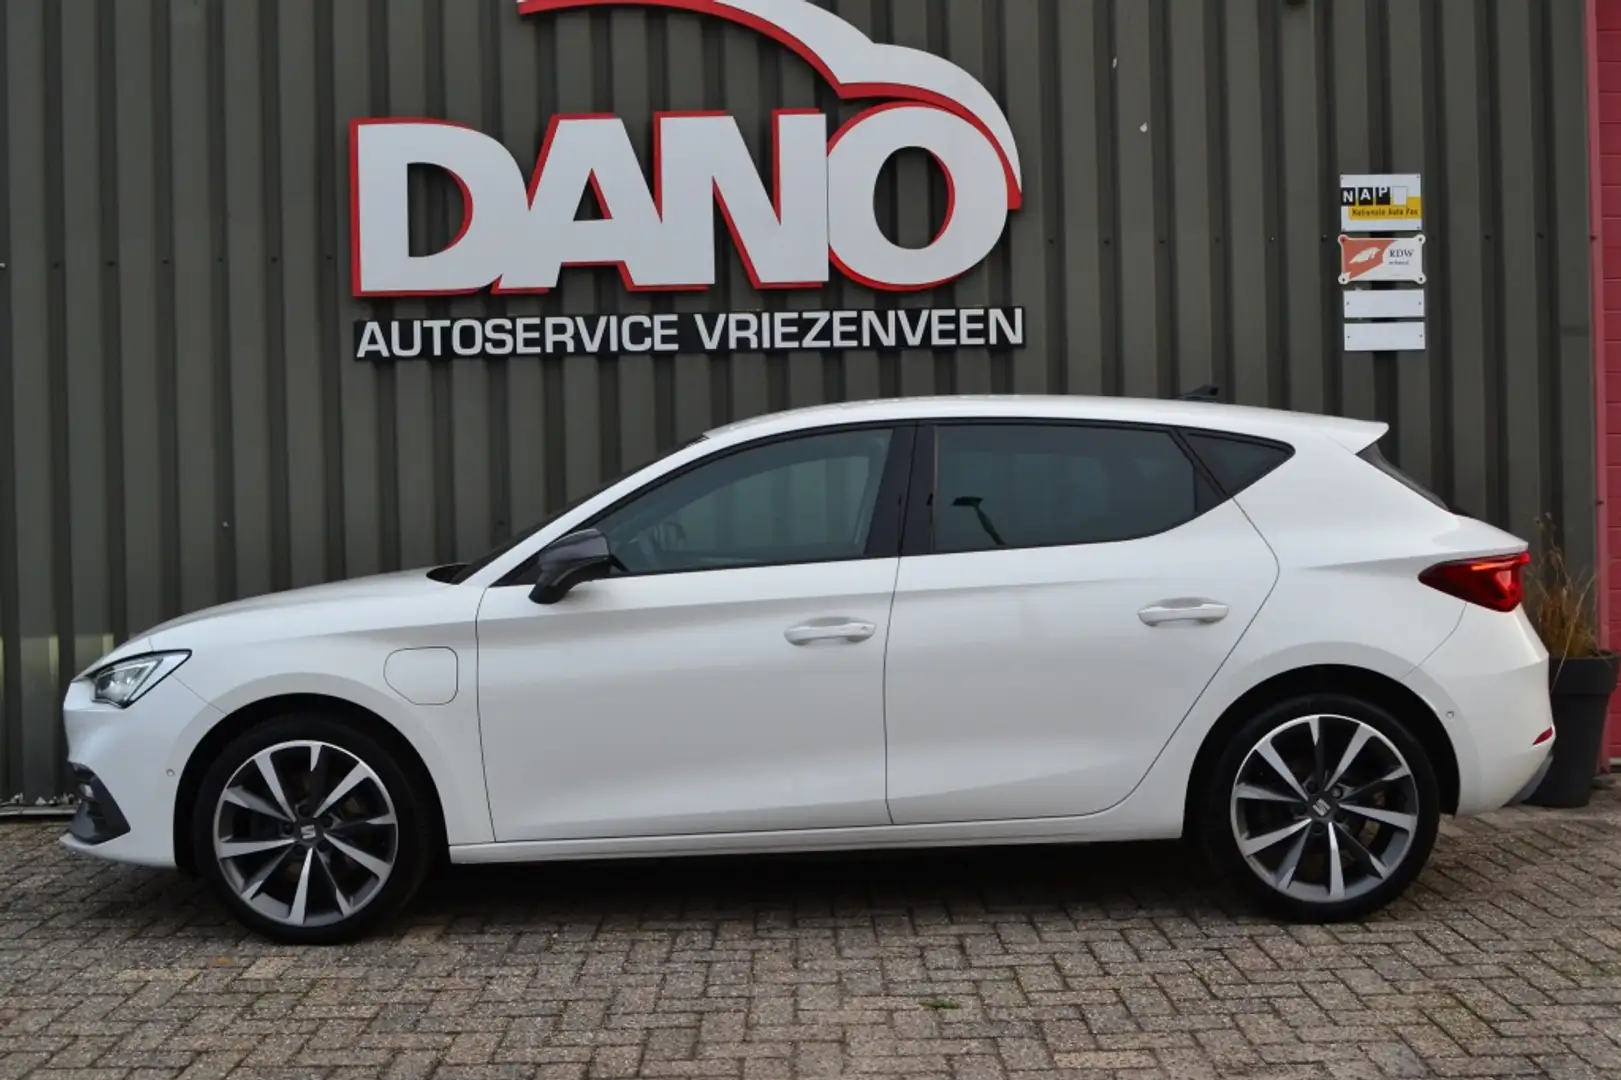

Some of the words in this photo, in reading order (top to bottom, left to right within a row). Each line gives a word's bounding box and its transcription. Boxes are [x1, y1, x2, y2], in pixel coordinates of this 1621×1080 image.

[352, 106, 1009, 295] DANO
[1342, 187, 1388, 203] NAP
[1390, 249, 1413, 258] RDW
[356, 313, 679, 358] AUTOSERVICE
[694, 307, 1025, 351] VRIEZENVEEN
